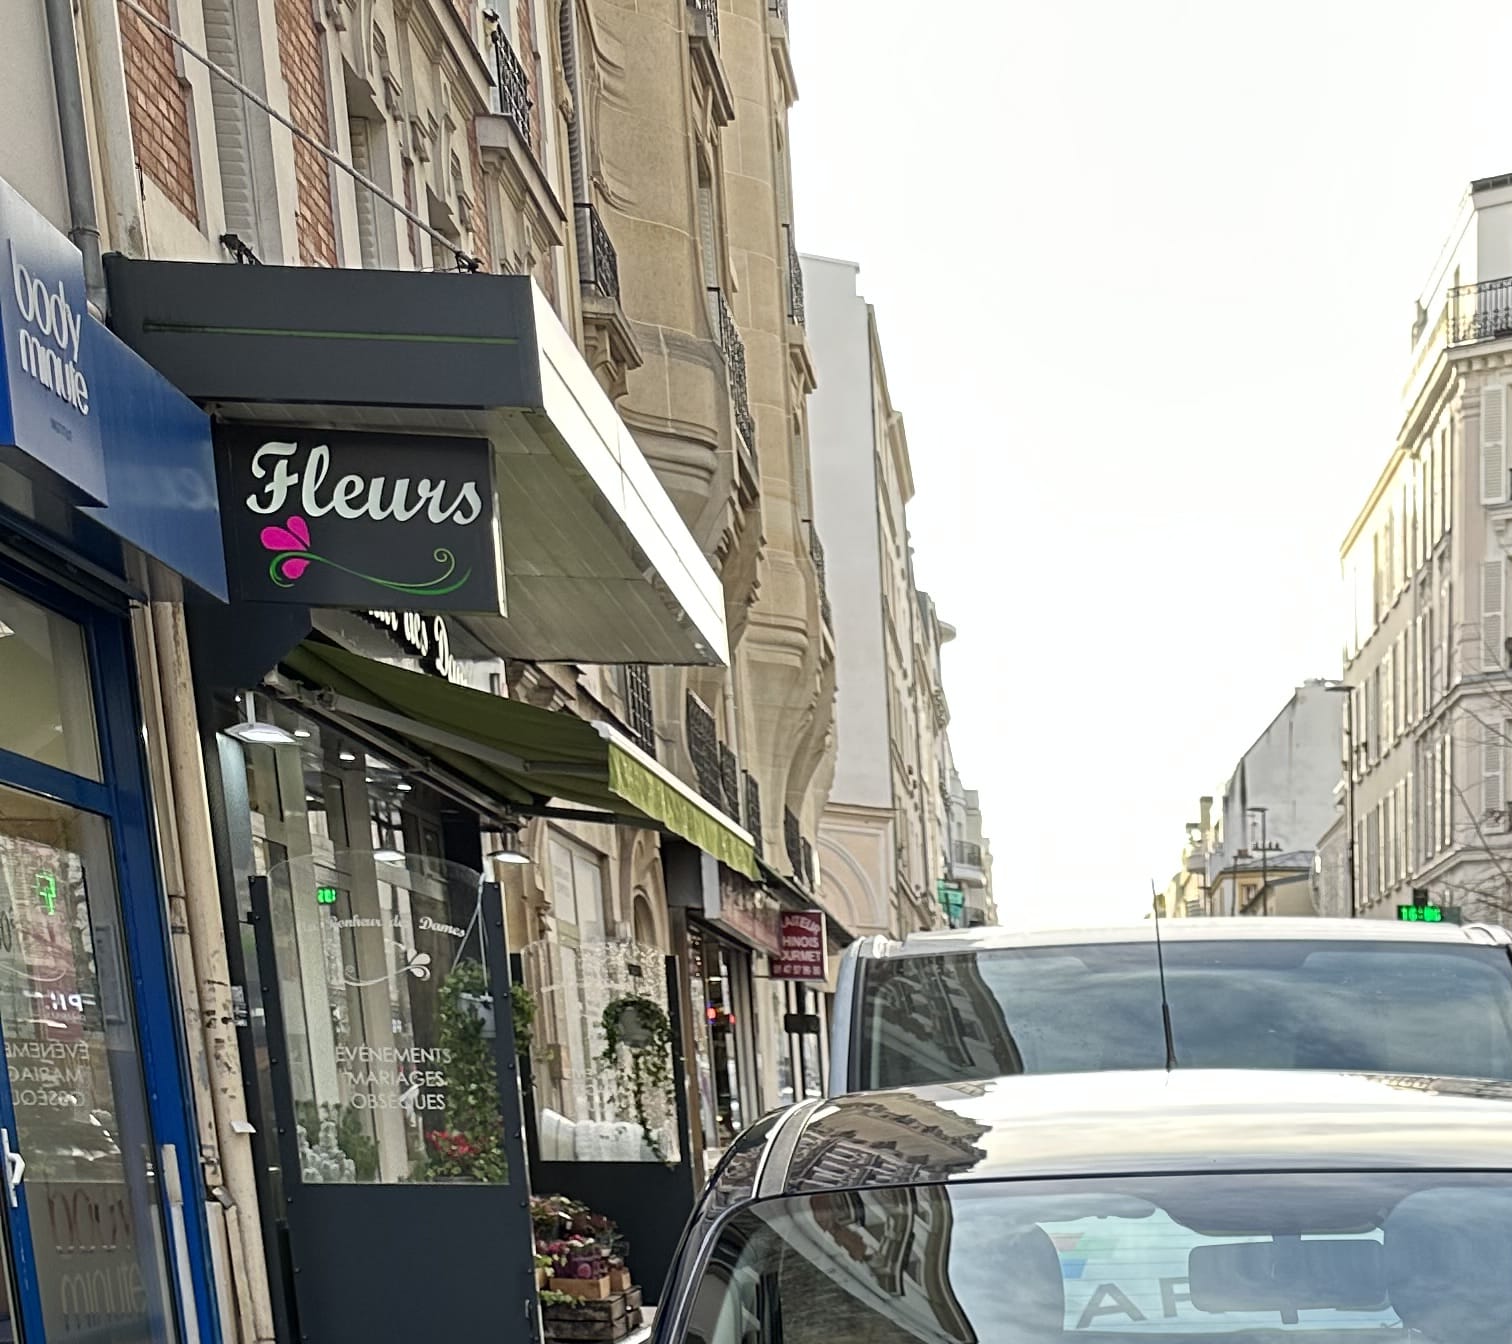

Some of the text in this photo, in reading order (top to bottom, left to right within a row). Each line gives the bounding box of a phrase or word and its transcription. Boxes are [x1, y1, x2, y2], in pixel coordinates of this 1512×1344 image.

[8, 239, 81, 363] body
[19, 329, 88, 416] minute
[246, 441, 482, 526] Fleurs
[418, 915, 466, 938] Dames
[782, 936, 820, 948] HINOIS
[347, 1070, 445, 1087] MARIAGES
